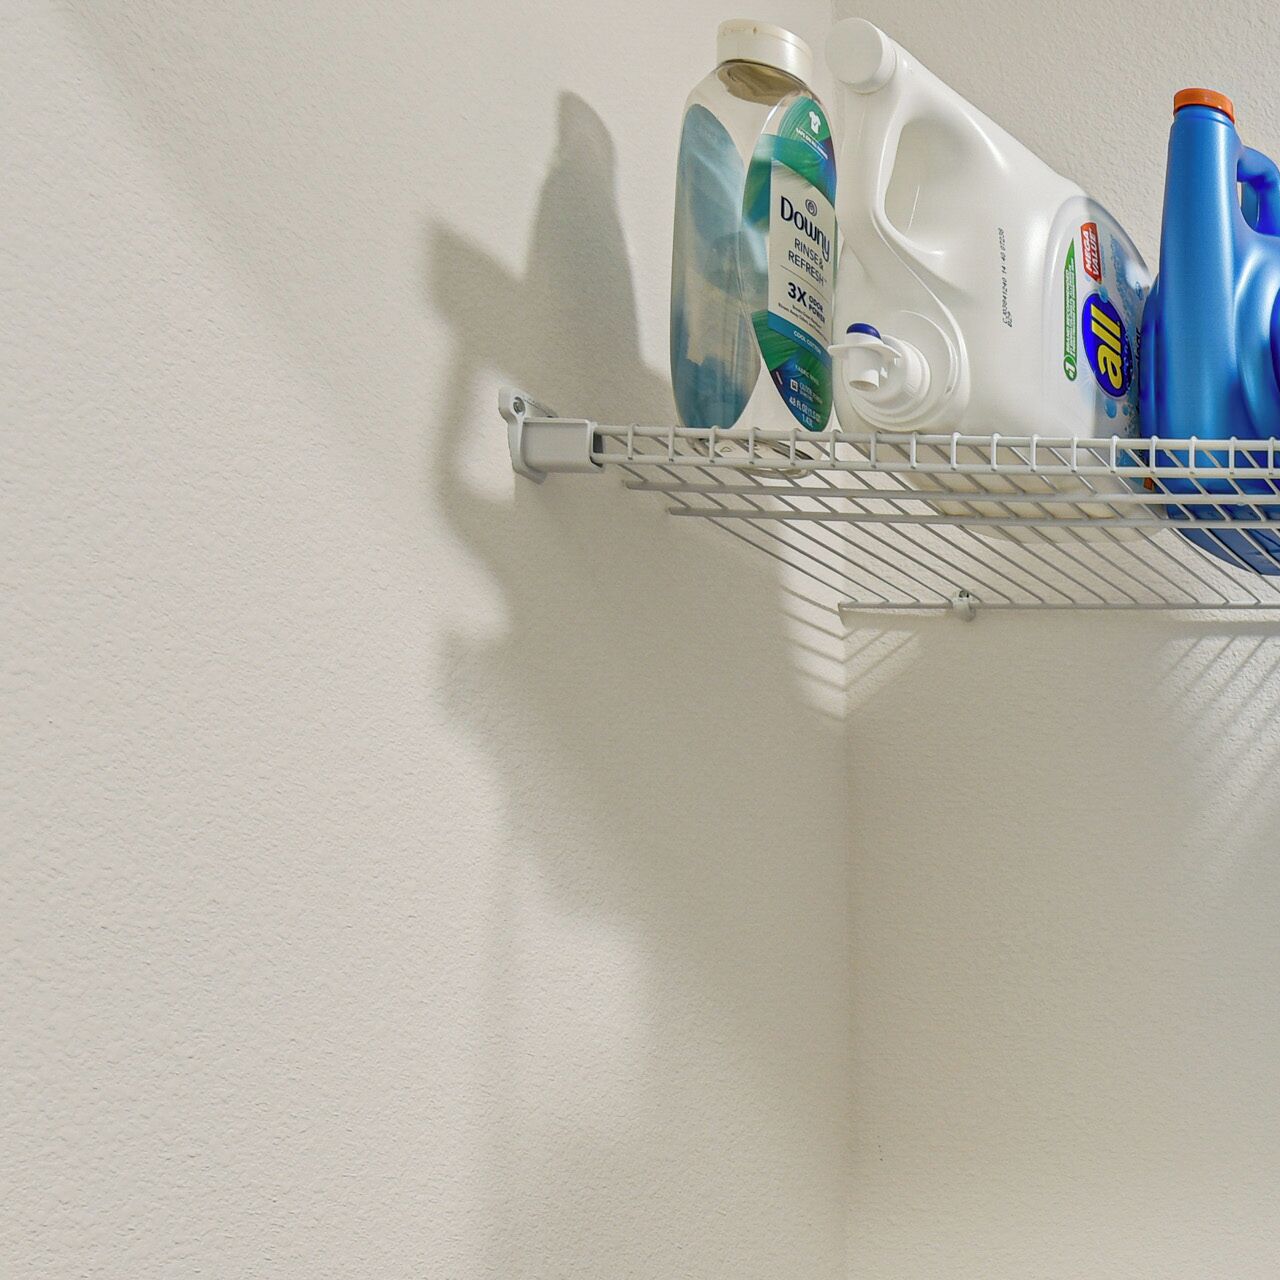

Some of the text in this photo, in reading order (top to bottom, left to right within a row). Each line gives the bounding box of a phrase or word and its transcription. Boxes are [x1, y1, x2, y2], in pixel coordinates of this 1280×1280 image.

[780, 195, 830, 262] Downy
[788, 250, 825, 286] REFRESH
[794, 238, 819, 266] RINSE
[1083, 230, 1093, 272] MEGA
[1088, 228, 1100, 276] VALUE
[787, 282, 807, 307] 3X
[1089, 303, 1122, 390] all
